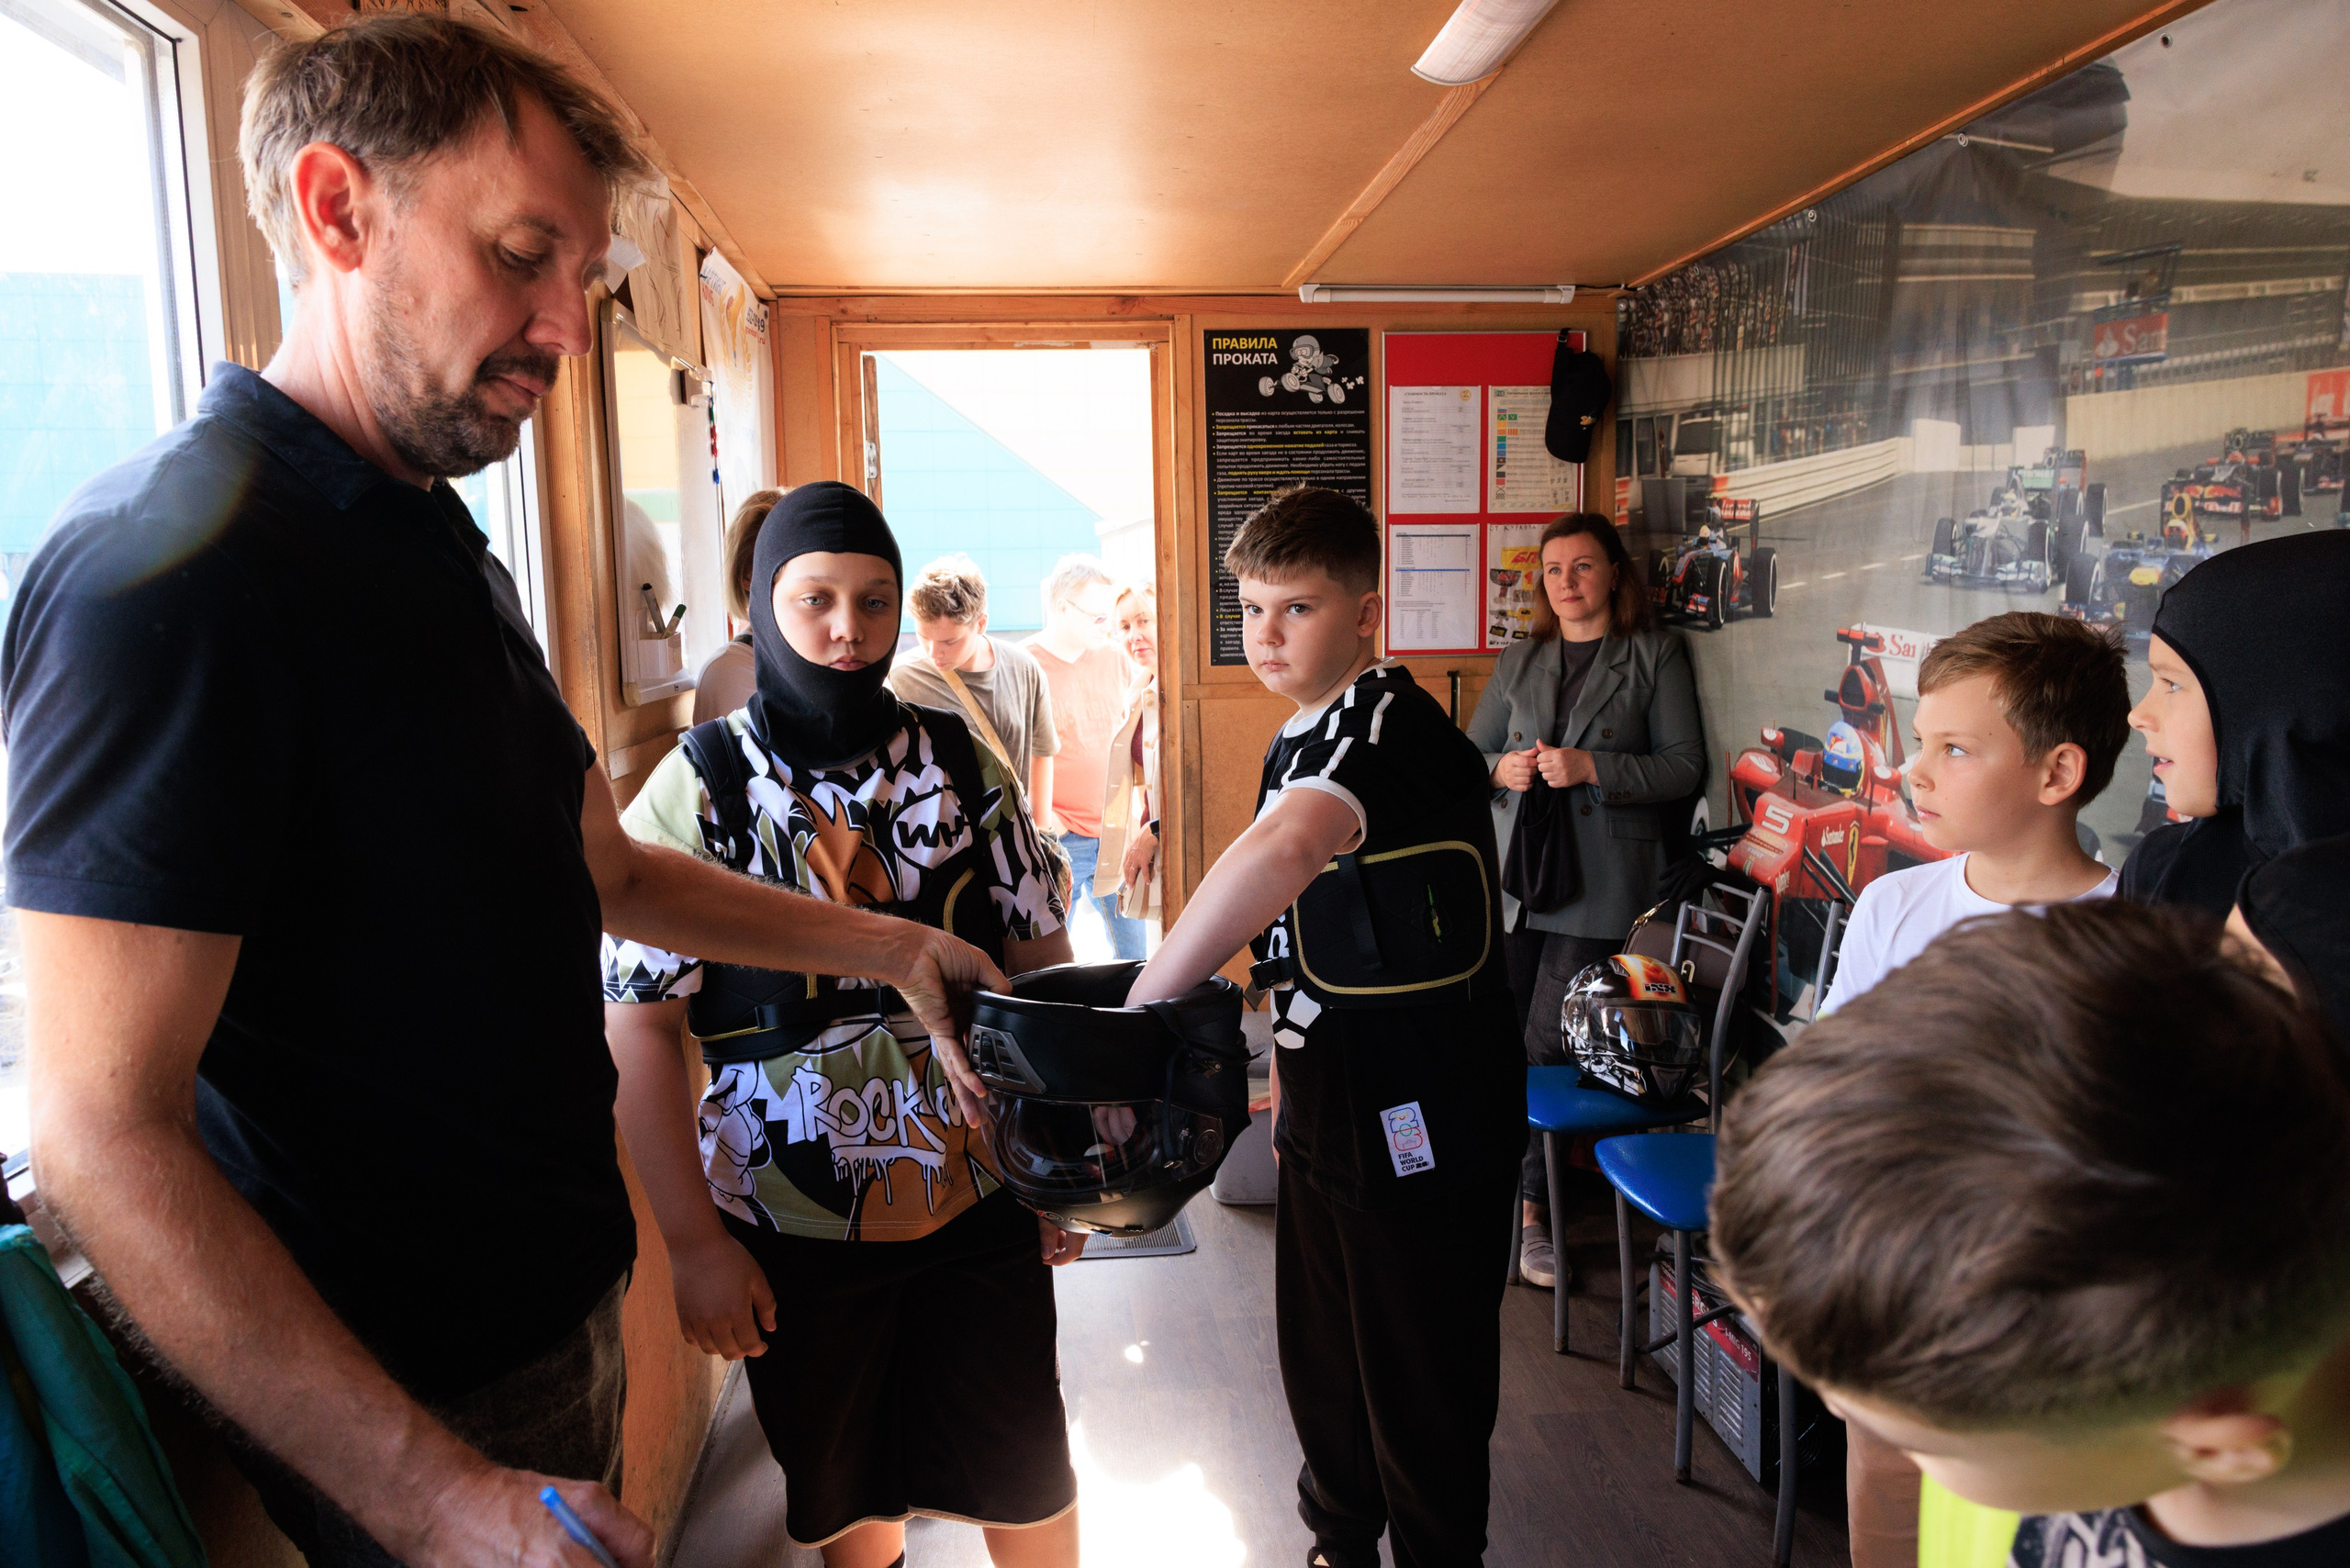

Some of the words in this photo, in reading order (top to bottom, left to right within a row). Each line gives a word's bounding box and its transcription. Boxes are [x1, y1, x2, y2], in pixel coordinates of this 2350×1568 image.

[1213, 338, 1278, 349] ПРАВИЛА
[1213, 353, 1278, 365] ПРОКАТА
[1762, 804, 1794, 834] 5
[791, 1065, 946, 1155] ROCK
[1398, 1151, 1413, 1159] FIFA
[1400, 1156, 1424, 1166] WORLD
[1741, 1345, 1751, 1361] 195
